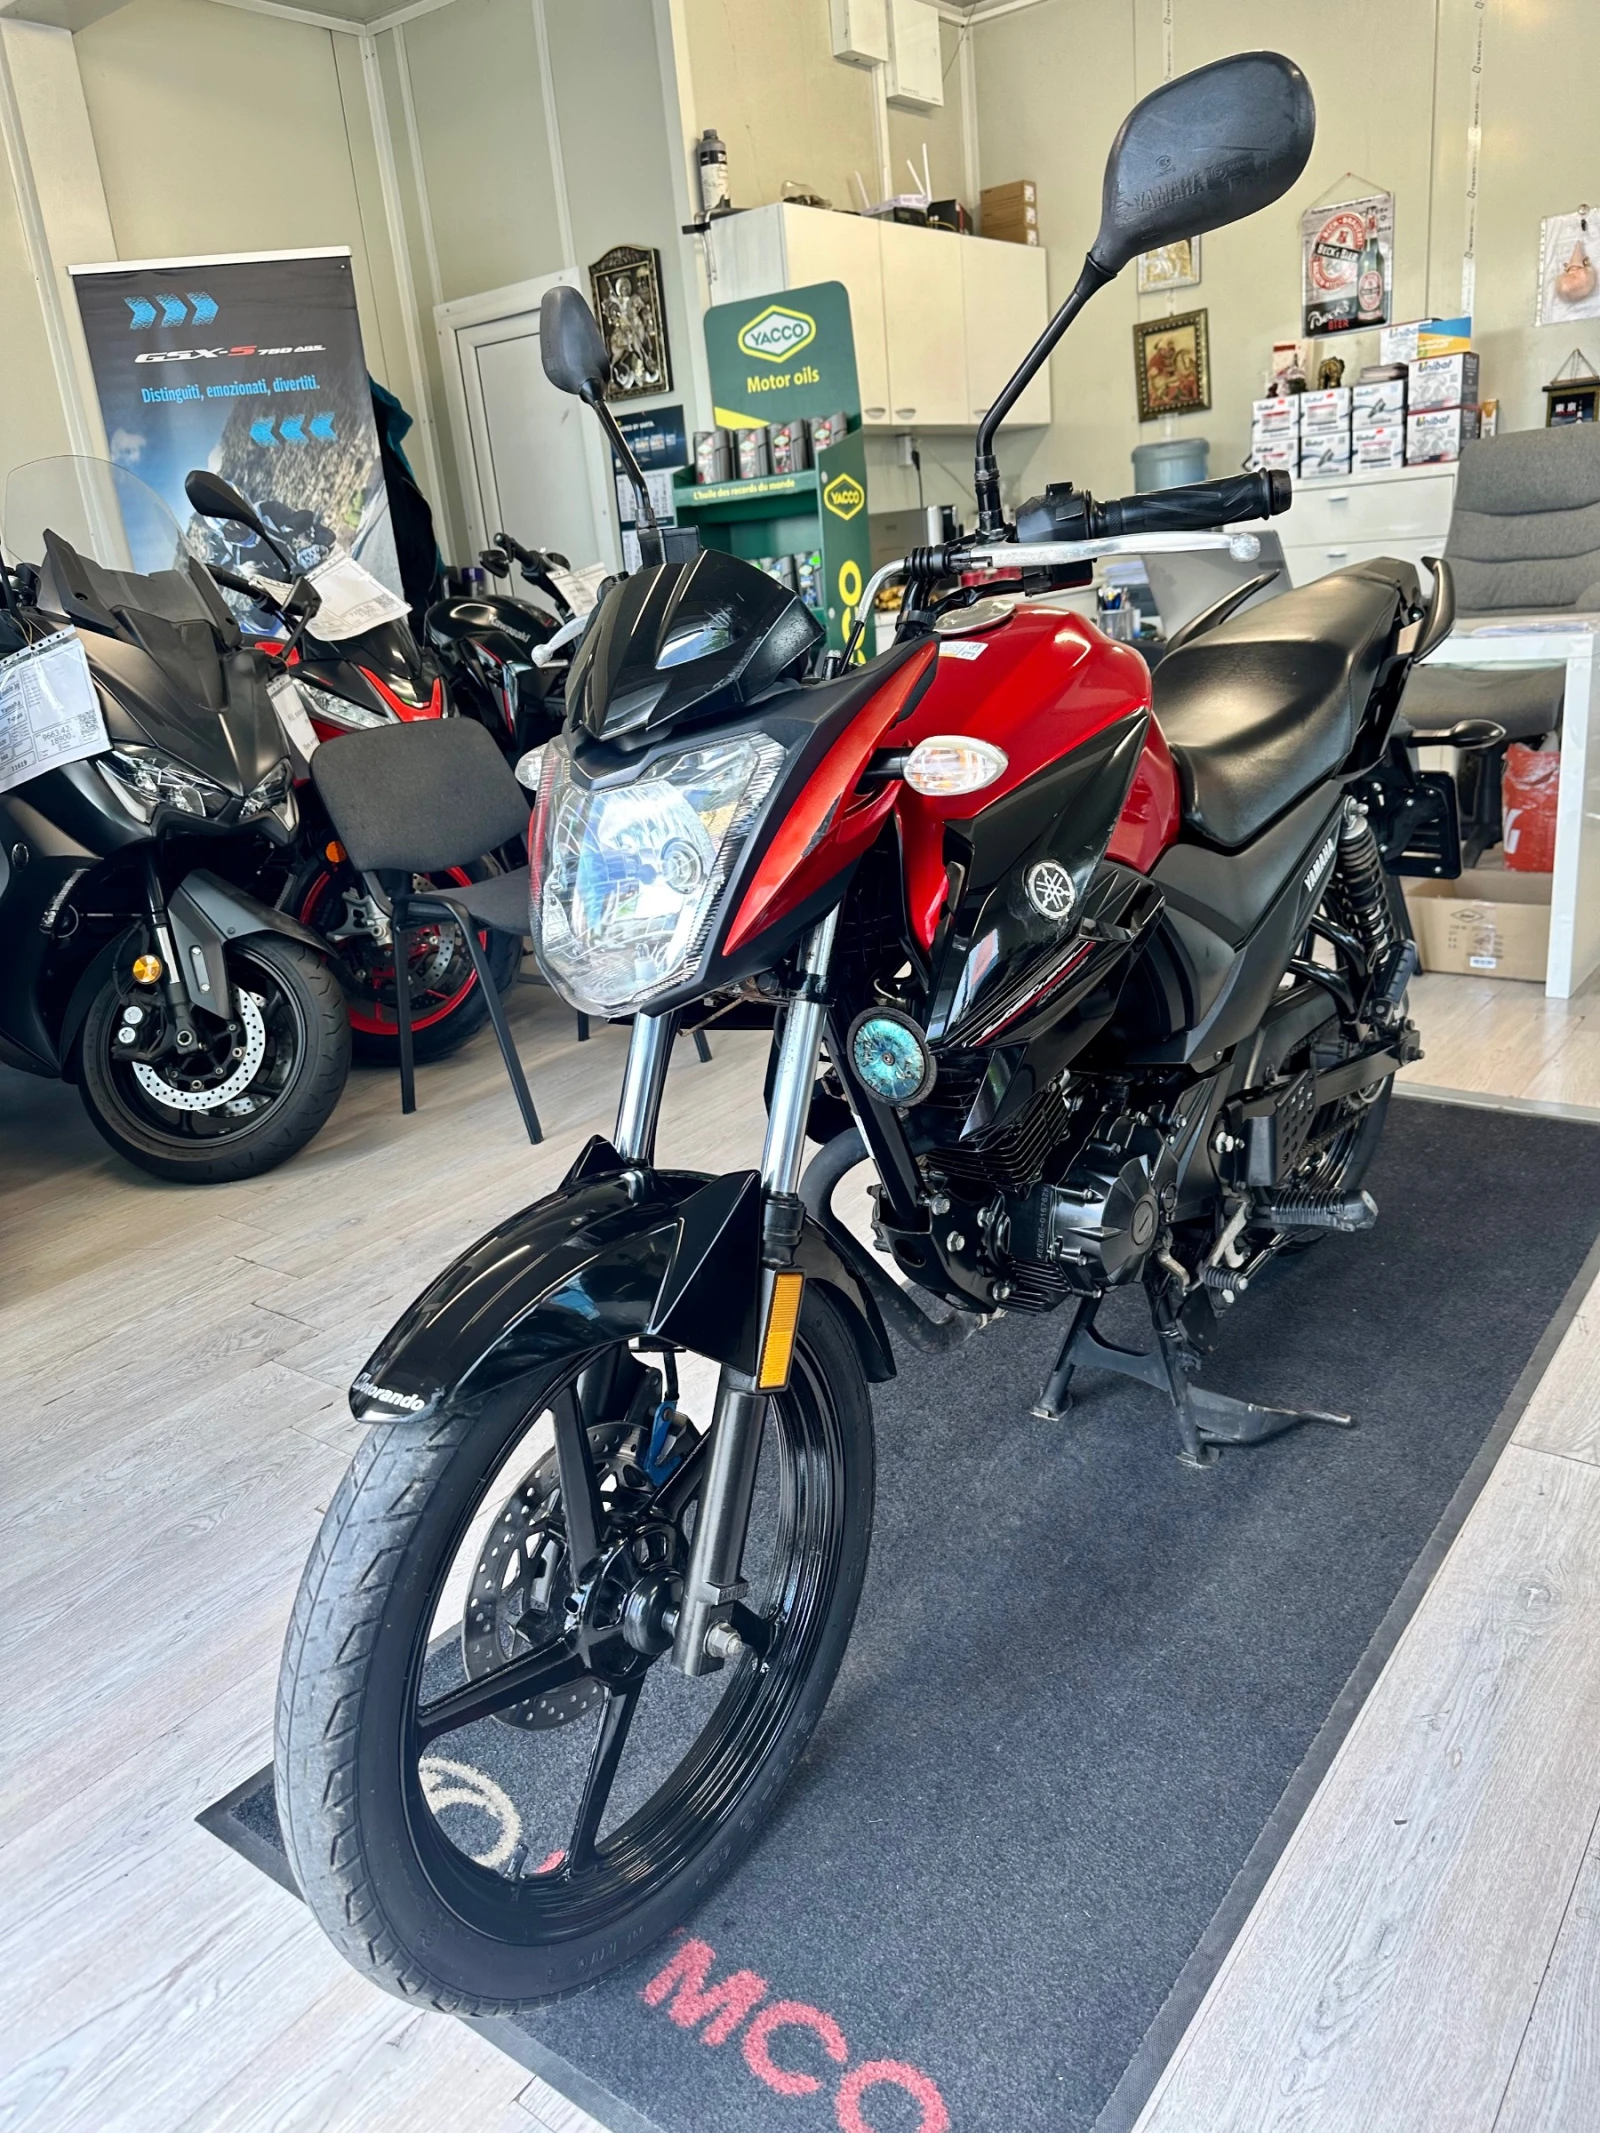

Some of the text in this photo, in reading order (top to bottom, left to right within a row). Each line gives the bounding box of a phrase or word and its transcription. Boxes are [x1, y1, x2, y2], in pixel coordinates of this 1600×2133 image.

[751, 323, 804, 346] YACCO
[1388, 326, 1419, 339] Uniba
[1418, 359, 1453, 373] Unibat
[141, 374, 321, 403] Distinguiti, emozionati, divertiti.
[746, 365, 820, 393] Motor oils
[1416, 415, 1450, 428] Unibat
[831, 490, 860, 505] YACCO
[489, 613, 531, 643] Kawasaki
[352, 1372, 425, 1411] Motorando
